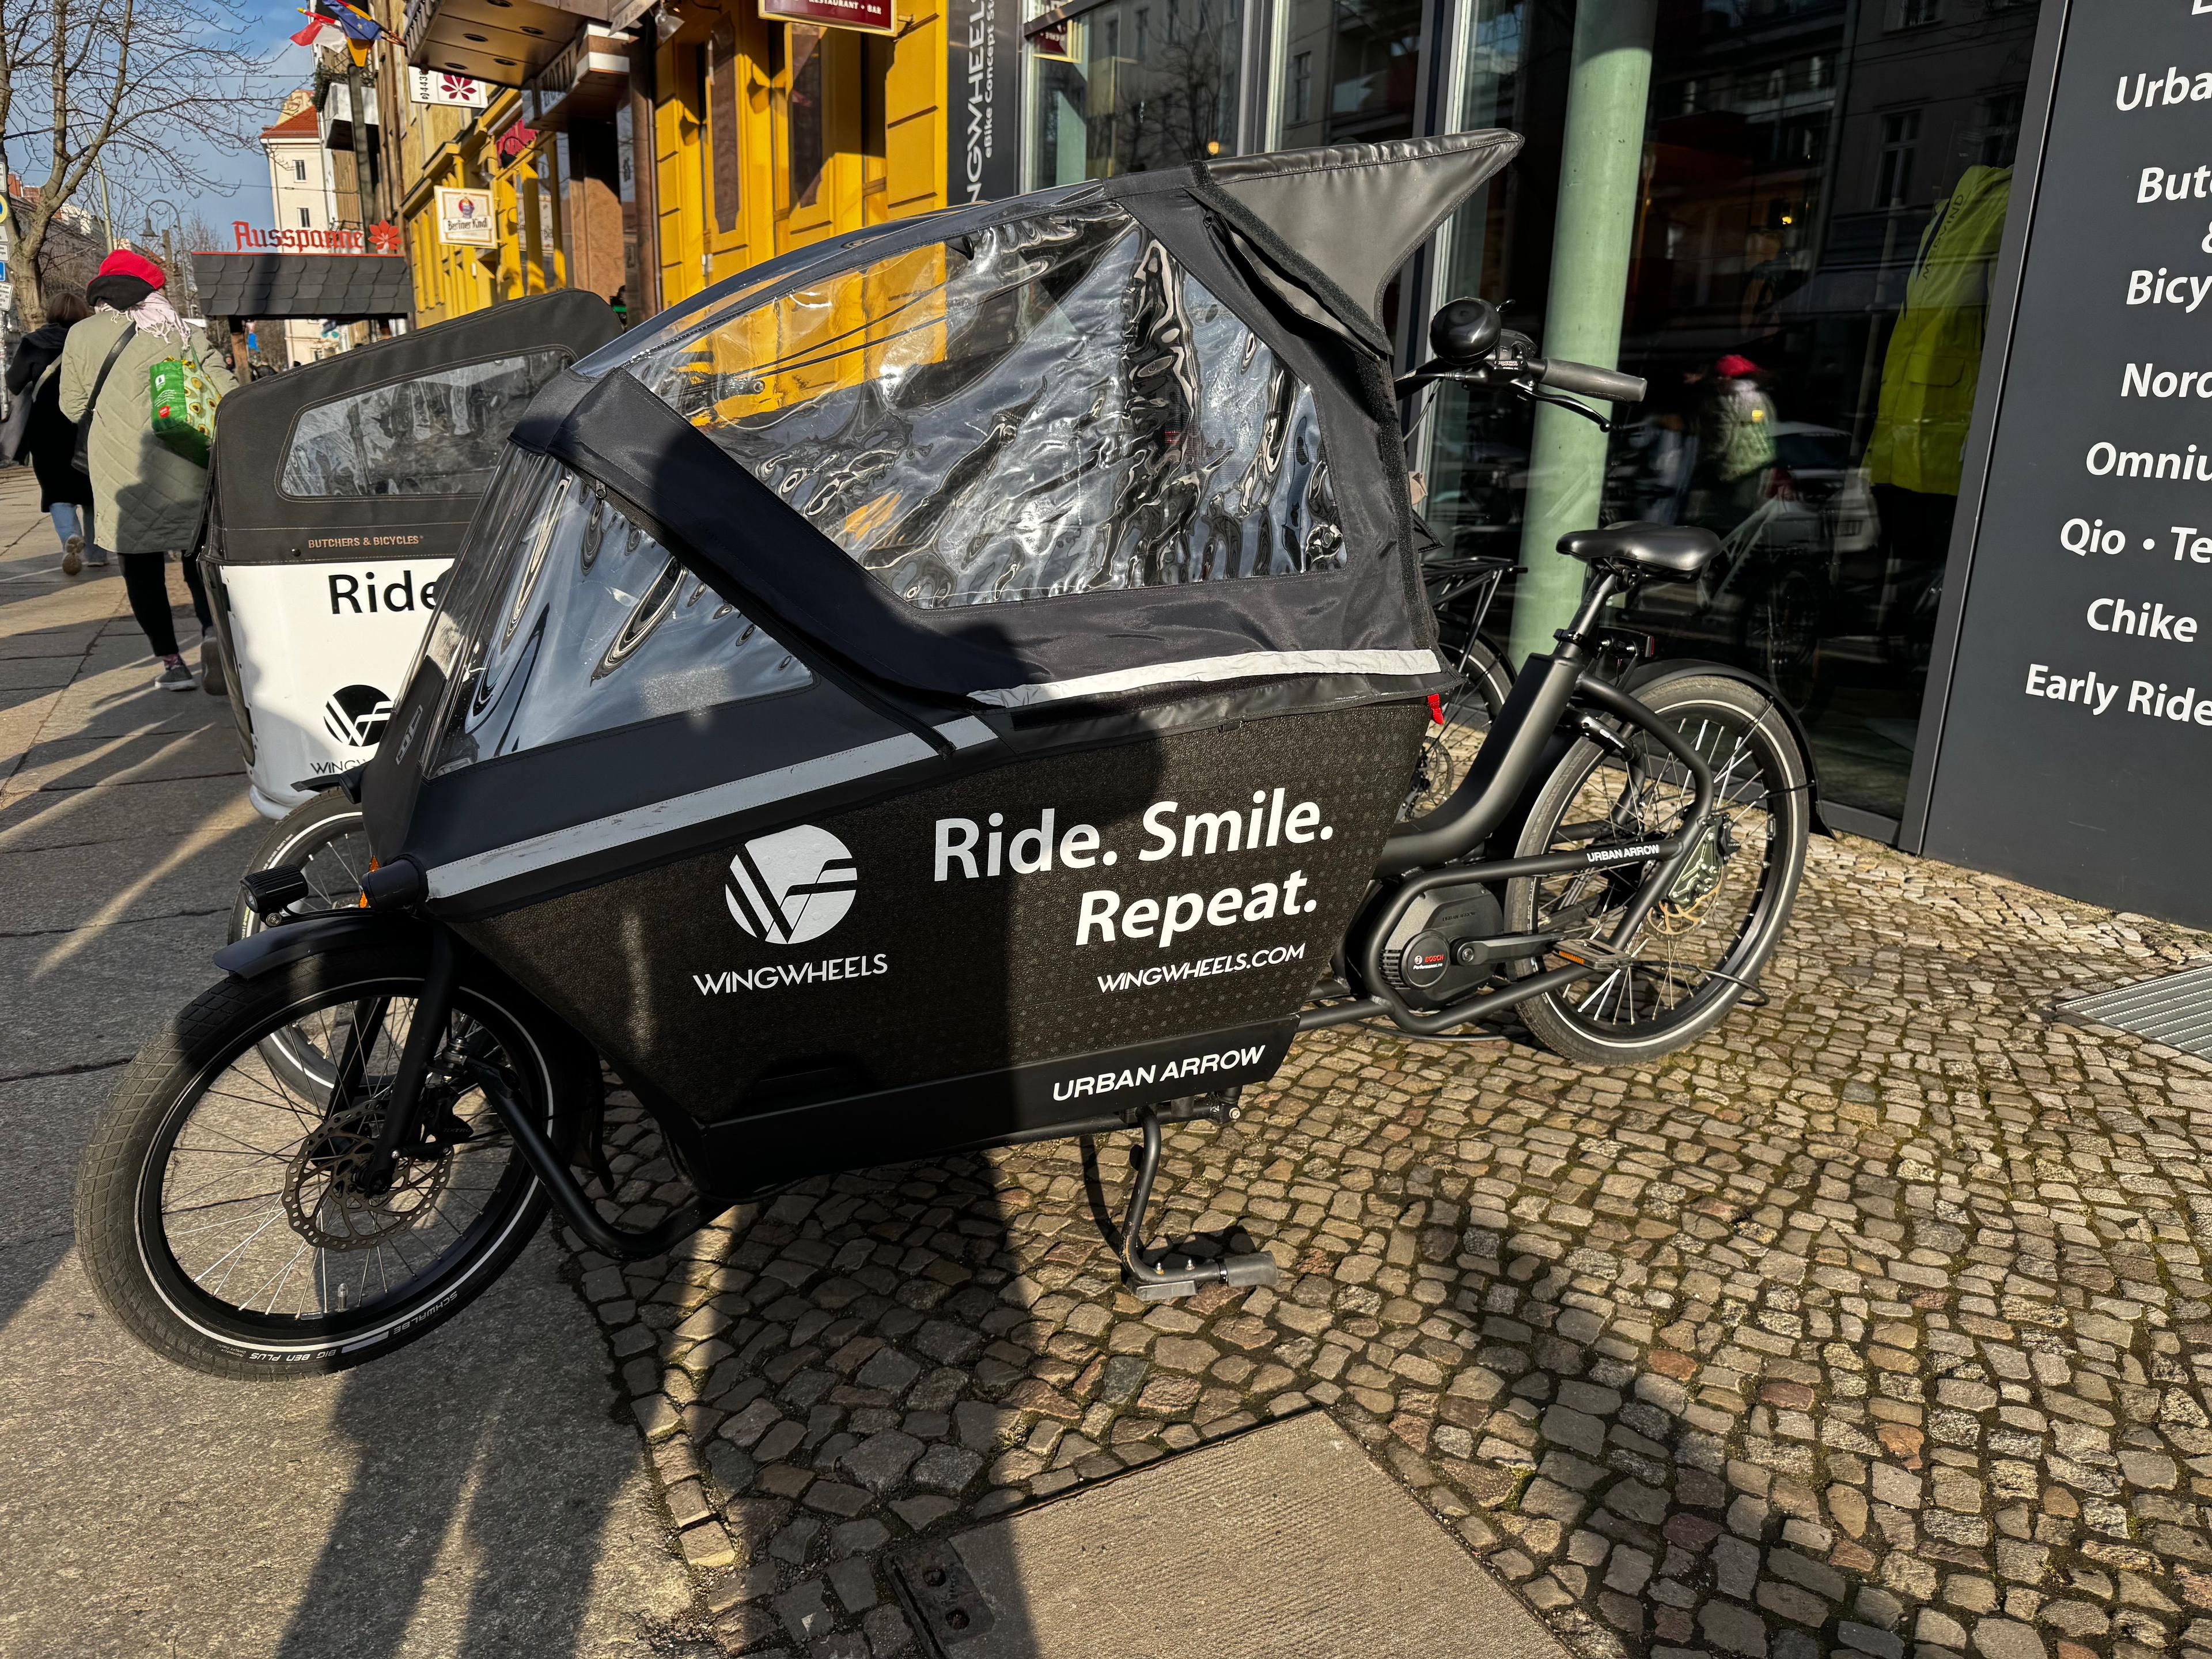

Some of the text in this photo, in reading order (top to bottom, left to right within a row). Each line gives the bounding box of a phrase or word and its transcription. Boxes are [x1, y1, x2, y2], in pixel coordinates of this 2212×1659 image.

[966, 0, 985, 202] NGWHEEL
[983, 0, 995, 158] eBike Concept St
[2137, 165, 2212, 203] But
[231, 220, 363, 253] Ausspanne
[2127, 267, 2212, 313] Bicy
[308, 537, 360, 548] BUTCHERS
[363, 537, 372, 546] &
[2061, 518, 2126, 556] Qio
[2087, 598, 2198, 642] Chike
[2025, 664, 2119, 715] Early
[934, 787, 1333, 882] Ride. Smile.
[1586, 844, 1660, 862] URBAN ARROW
[1075, 869, 1317, 948] Repeat.
[692, 953, 888, 996] WINGWHEELS
[1097, 943, 1305, 994] WINGWHEELS.COM
[1425, 954, 1444, 963] BOSCH
[1053, 1044, 1266, 1101] URBAN ARROW
[392, 1290, 458, 1335] SCHWALBE
[249, 1352, 283, 1362] PLUS
[316, 1349, 336, 1359] BIG
